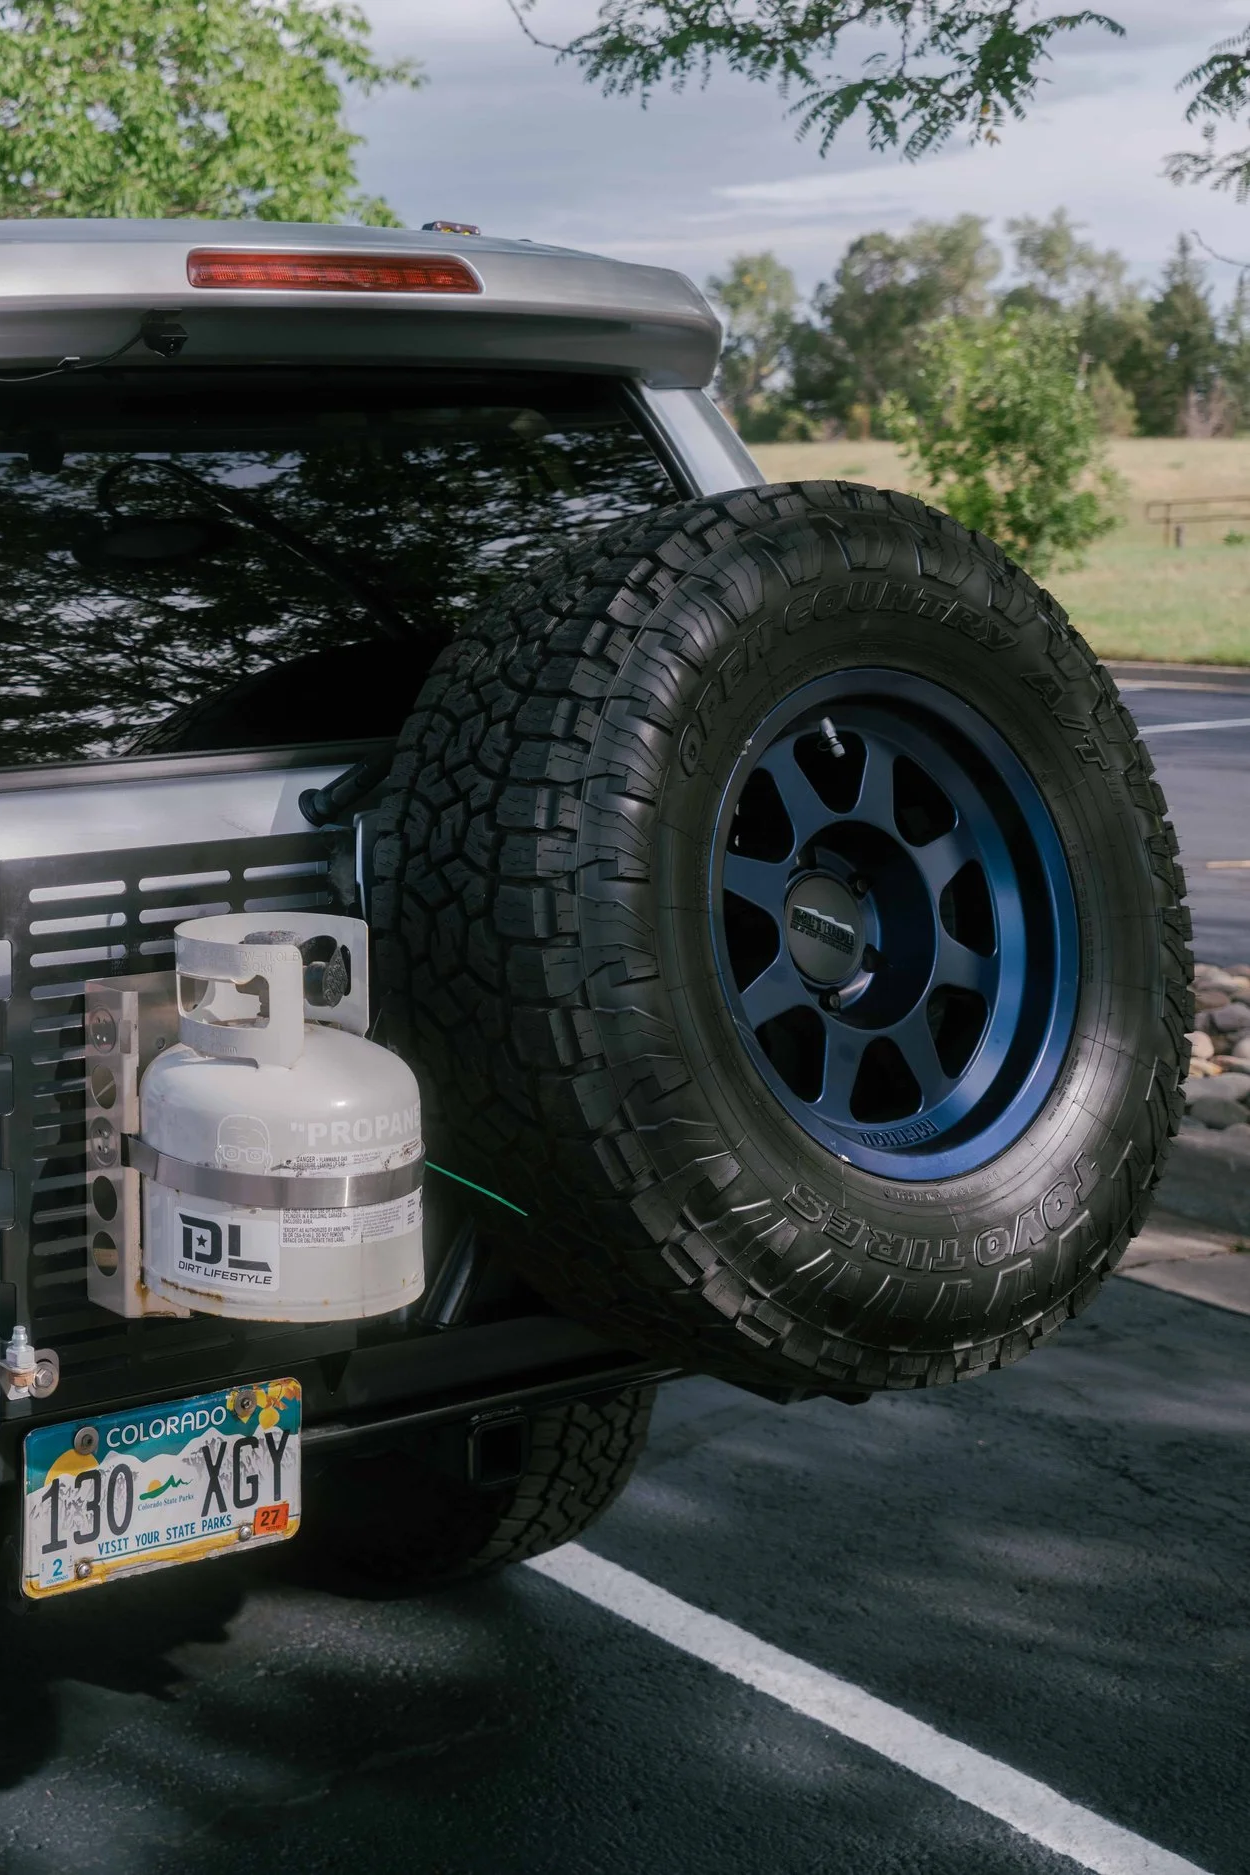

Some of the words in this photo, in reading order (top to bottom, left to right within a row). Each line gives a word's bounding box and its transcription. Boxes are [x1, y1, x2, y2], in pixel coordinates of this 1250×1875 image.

[784, 581, 1020, 652] COUNTRY
[782, 1182, 966, 1273] TIRES
[974, 1151, 1101, 1268] TOYO
[179, 1213, 272, 1272] DL
[178, 1260, 201, 1274] DIRT
[204, 1269, 273, 1285] LIFESTYLE
[106, 1406, 227, 1448] COLORADO
[41, 1463, 134, 1555] 130
[200, 1429, 290, 1518] XGY
[137, 1497, 163, 1512] Colorado
[163, 1496, 178, 1508] State
[178, 1493, 194, 1504] Parks
[98, 1537, 129, 1556] VISIT
[135, 1529, 160, 1546] YOUR
[166, 1522, 196, 1541] STATE
[202, 1515, 232, 1532] PARKS
[260, 1509, 280, 1527] 27
[52, 1558, 63, 1577] 2
